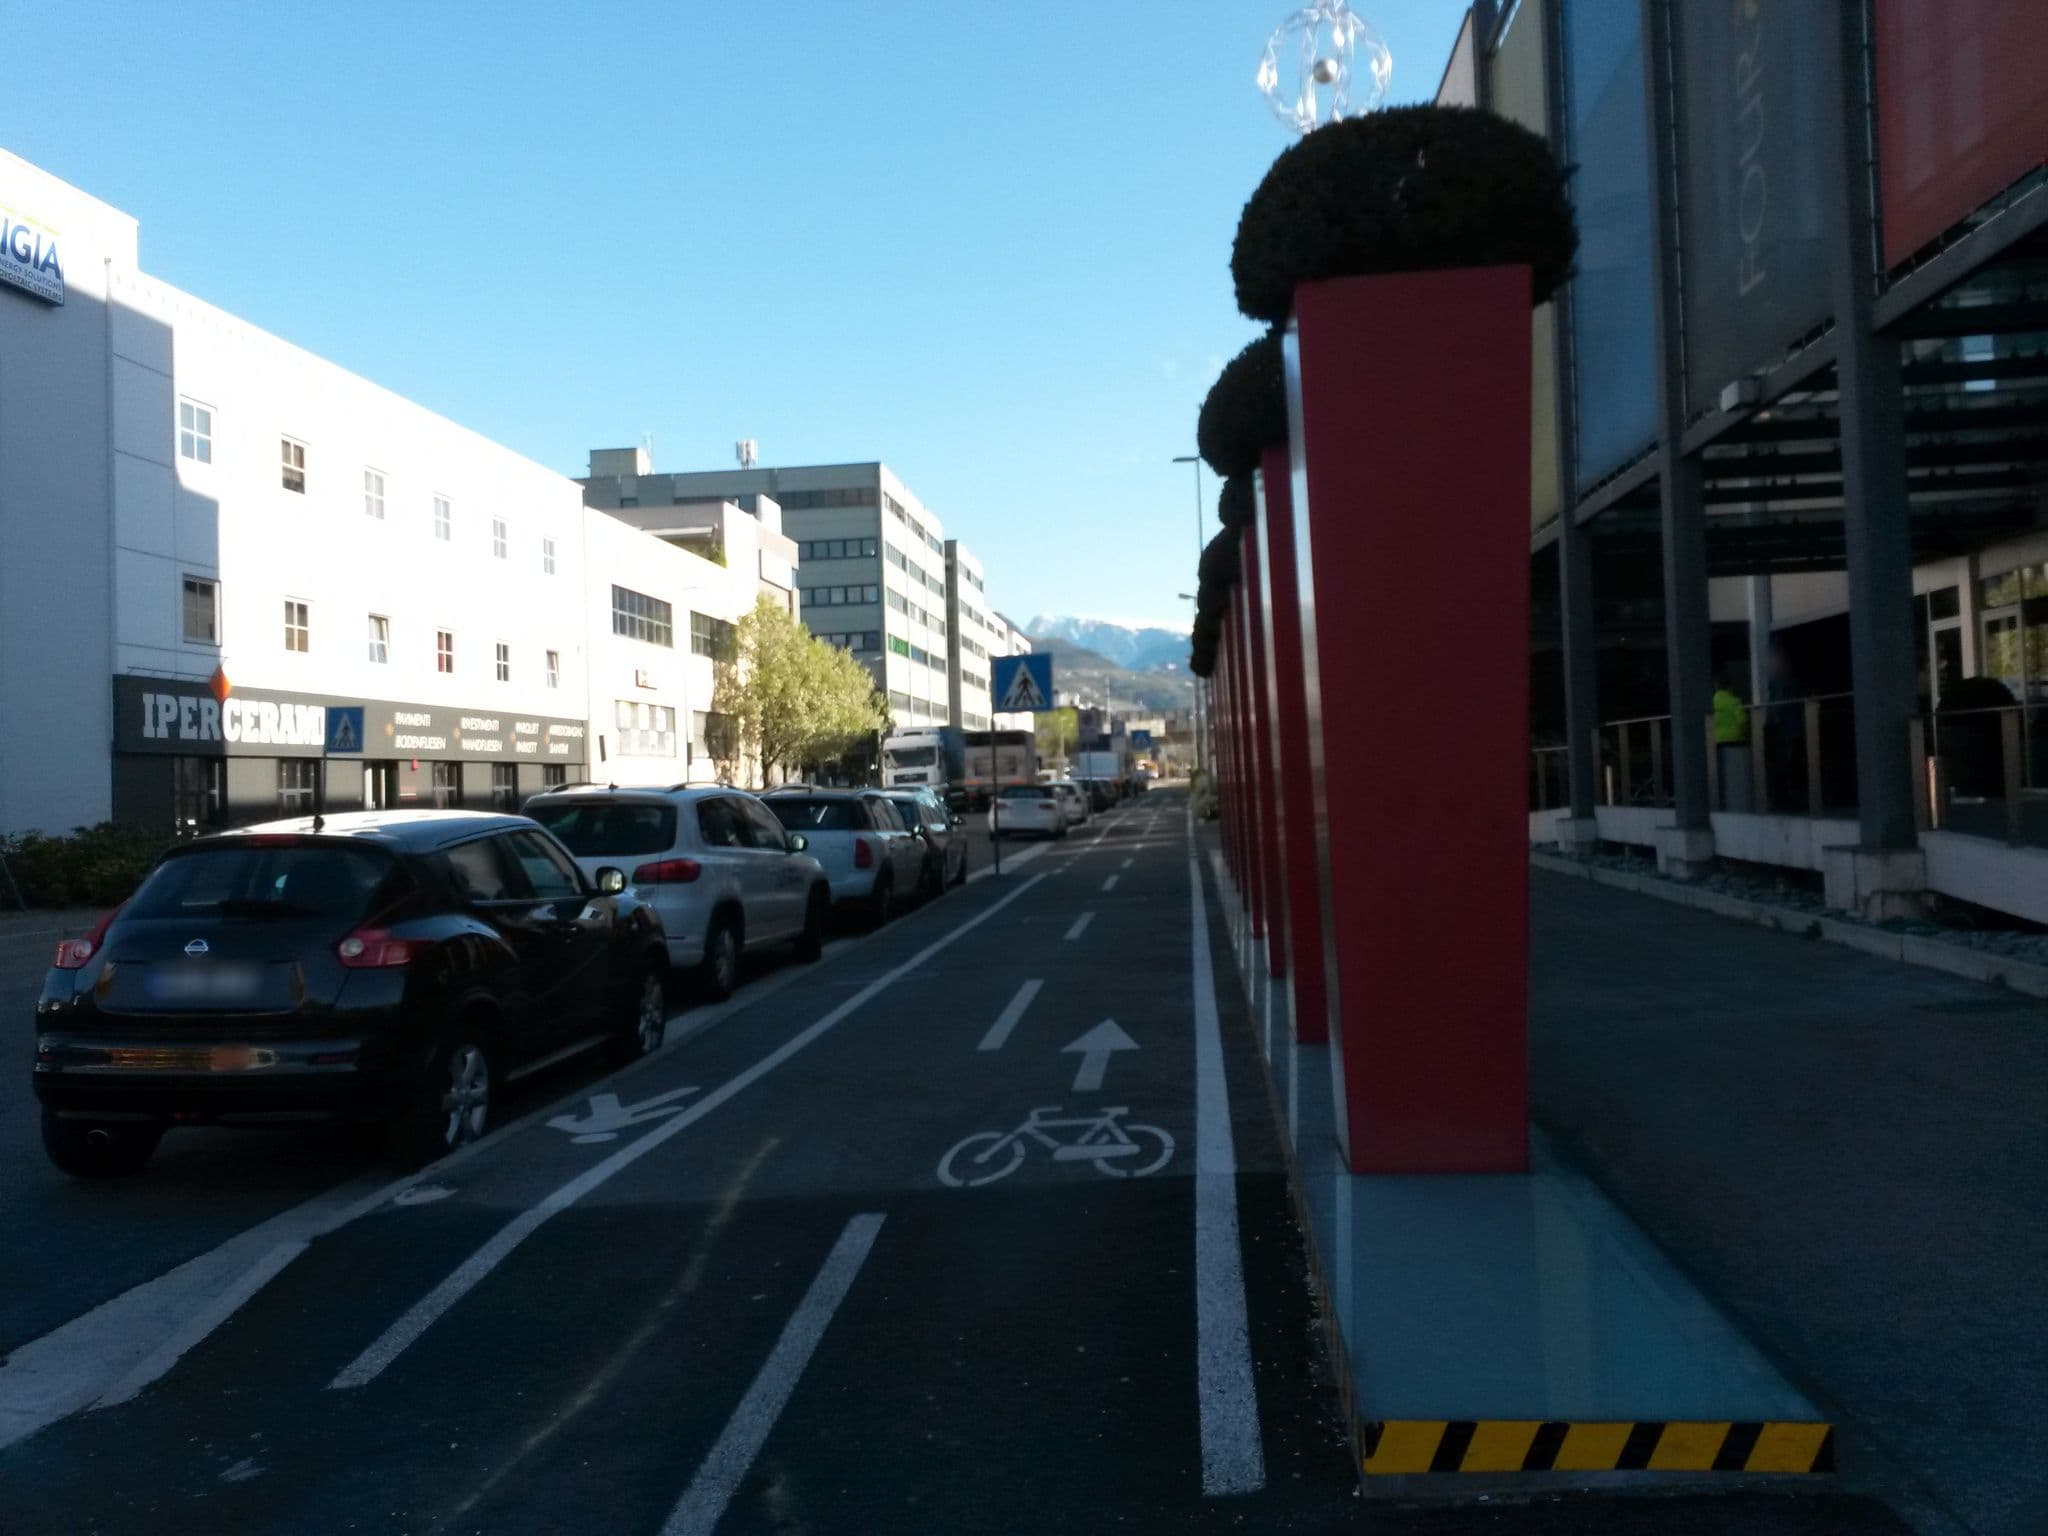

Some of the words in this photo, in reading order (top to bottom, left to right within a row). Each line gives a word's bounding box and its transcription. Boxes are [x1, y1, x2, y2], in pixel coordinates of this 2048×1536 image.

[1735, 23, 1767, 297] FOUR
[394, 711, 431, 728] PAVIMENTI
[394, 734, 447, 751] BODENFLIESEN
[461, 738, 503, 752] WANDFLIESEN
